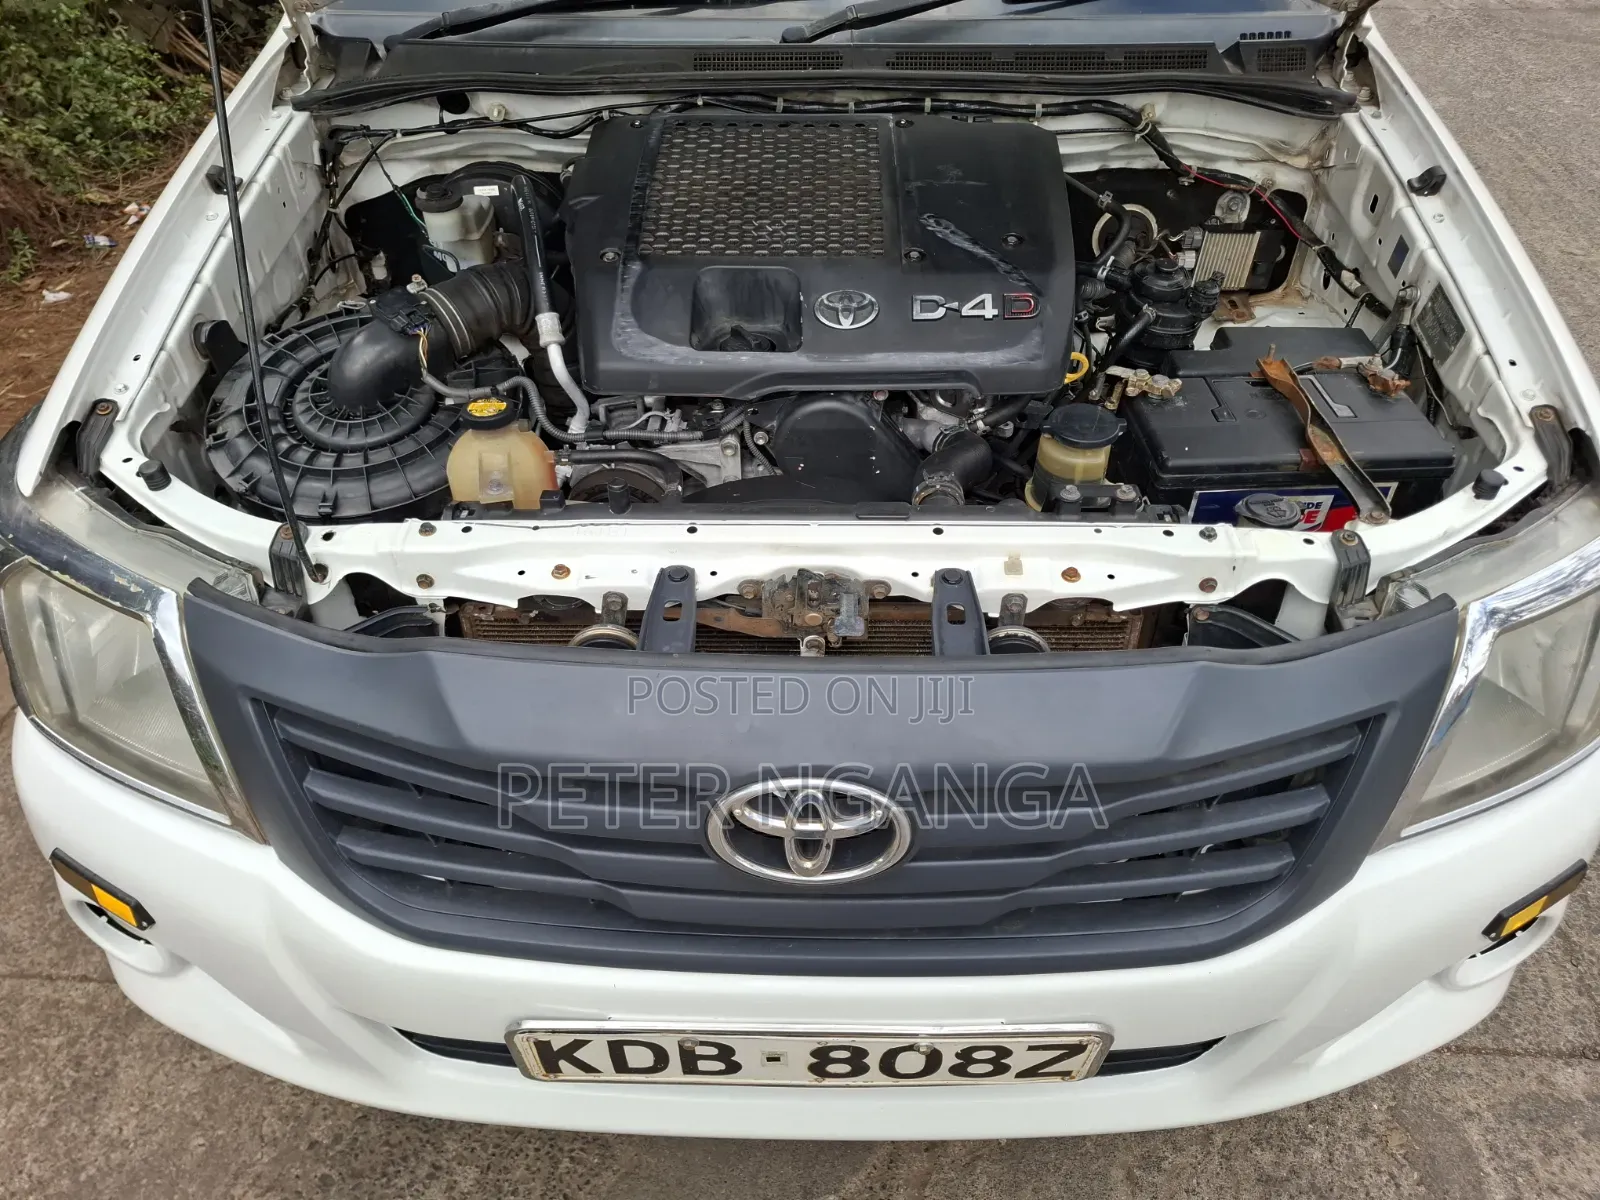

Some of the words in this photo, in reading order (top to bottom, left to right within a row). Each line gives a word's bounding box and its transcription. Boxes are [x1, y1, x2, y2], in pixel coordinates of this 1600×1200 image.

[912, 293, 1040, 320] D-4D
[533, 1038, 743, 1076] KDB
[807, 1043, 1089, 1080] 808Z
